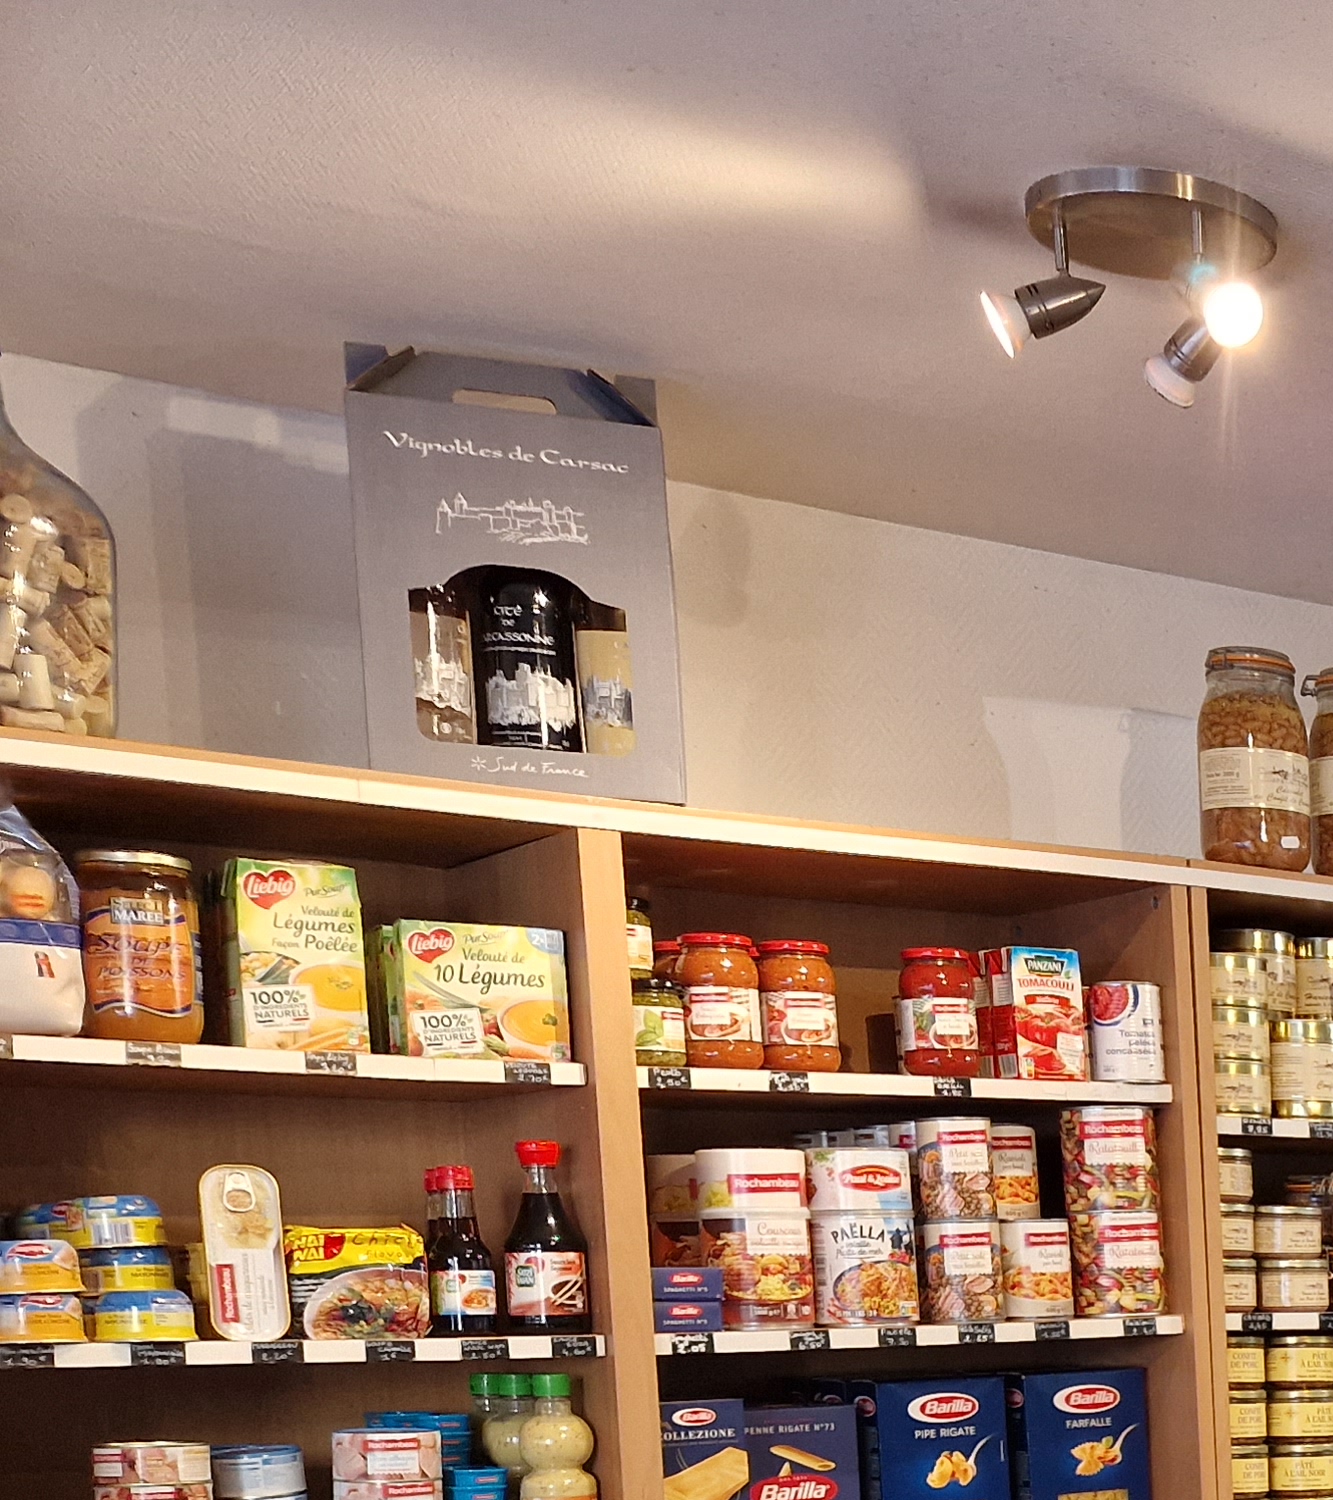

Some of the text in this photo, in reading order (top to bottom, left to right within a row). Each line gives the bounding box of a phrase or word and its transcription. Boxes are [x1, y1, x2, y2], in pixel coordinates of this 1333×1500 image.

[383, 430, 629, 475] Vignobles de Carsac
[487, 757, 589, 778] Sud de France
[246, 874, 294, 898] Liebig
[301, 905, 355, 918] Velouté de
[273, 916, 356, 938] Légumes
[304, 936, 358, 953] Poêlée
[410, 931, 454, 953] Liebig
[461, 947, 525, 964] Velouté de
[1027, 958, 1062, 972] PANZANI
[434, 964, 546, 995] 10 Légumes
[1017, 978, 1075, 991] TOMACOULI
[250, 990, 299, 1004] 100%
[254, 1009, 310, 1020] NATURELS
[420, 1015, 467, 1029] 100%
[733, 1177, 799, 1189] Rochambeau
[757, 1223, 803, 1236] Couscous
[832, 1222, 885, 1244] PAËLLA
[744, 1426, 775, 1435] PENNE
[778, 1424, 811, 1434] RIGATE
[1065, 1417, 1112, 1429] FARFALLE
[662, 1428, 736, 1442] OLLEZIONE
[914, 1426, 976, 1439] PIPE RIGATE
